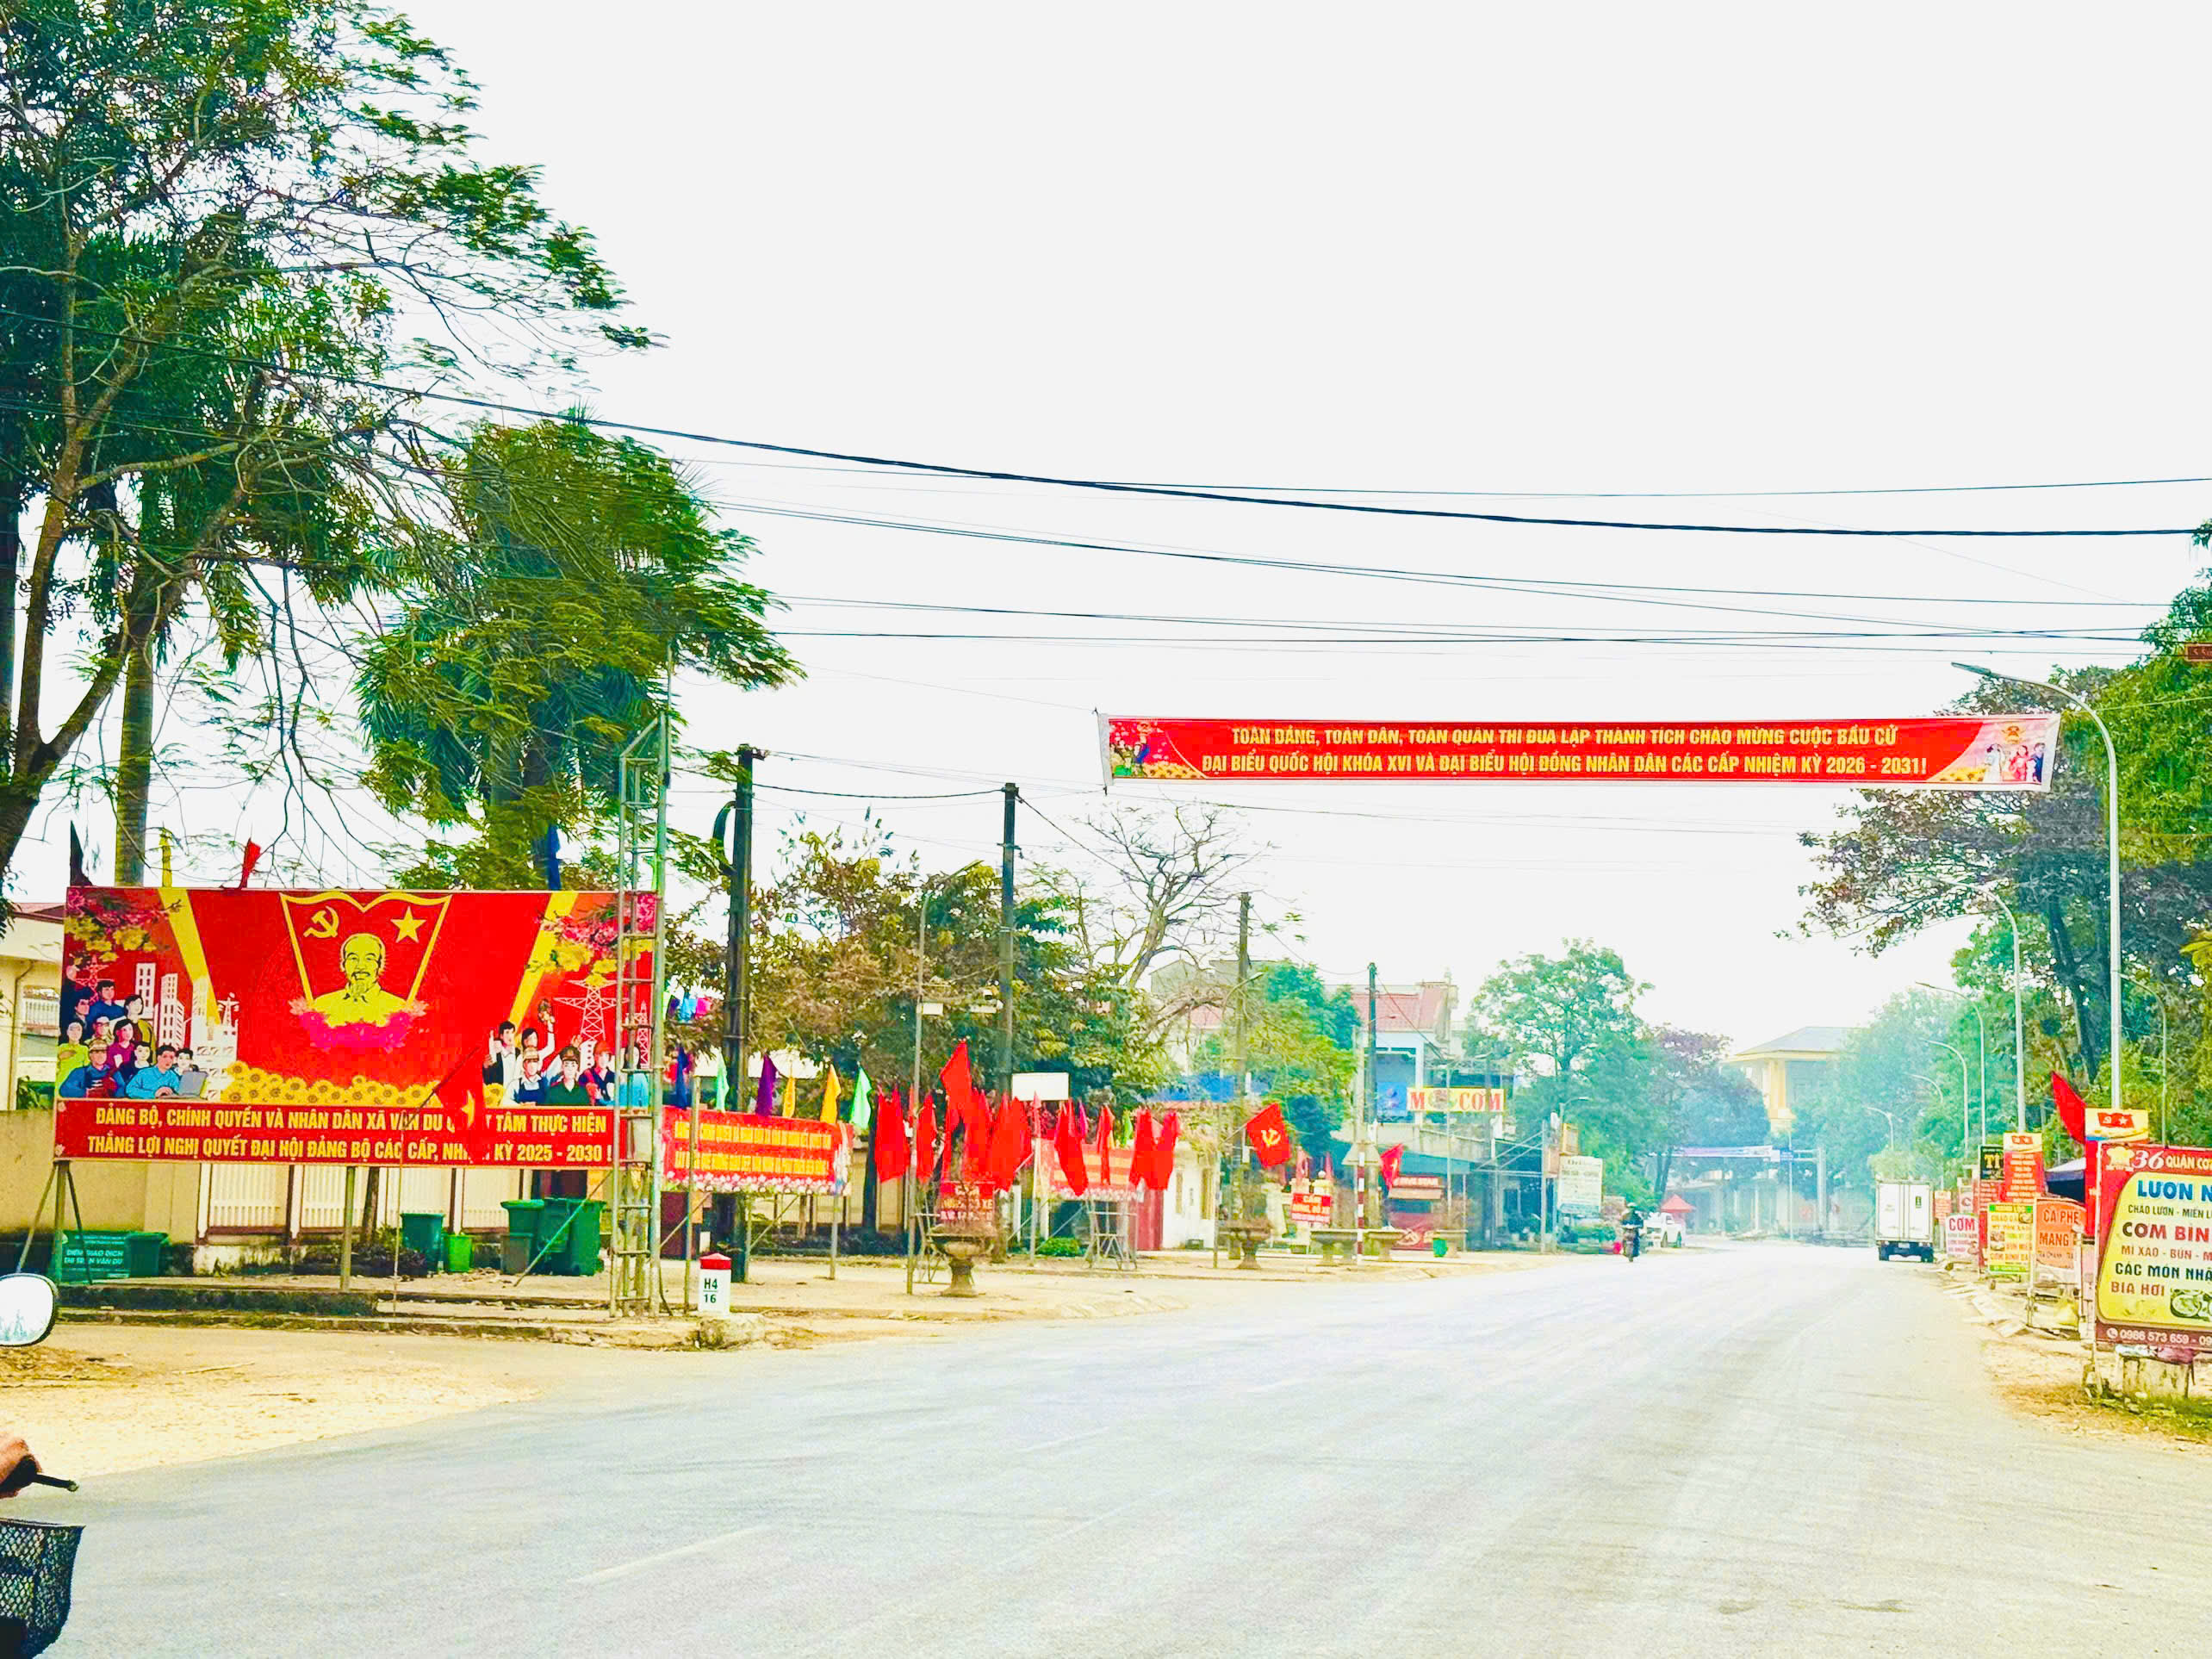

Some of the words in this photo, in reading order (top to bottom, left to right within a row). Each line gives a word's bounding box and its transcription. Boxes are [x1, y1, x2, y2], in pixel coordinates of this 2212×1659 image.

[1275, 724, 1320, 746] ĐẢNG,
[1324, 726, 1364, 744] TOÀN
[1408, 726, 1448, 744] TOÀN
[1452, 726, 1494, 746] QUÂN
[1499, 729, 1522, 744] THI
[1526, 729, 1556, 744] ĐUA
[1561, 727, 1591, 748] LẬP
[1595, 727, 1646, 744] THÀNH
[1650, 726, 1685, 744] TÍCH
[1689, 726, 1732, 744] CHÀO
[1737, 726, 1785, 744] MỪNG
[1789, 726, 1832, 749] CUỘC
[1874, 724, 1898, 745] CỬ
[1202, 755, 1227, 774] ĐẠI
[1269, 750, 1309, 774] QUỐC
[1313, 753, 1339, 774] HỘI
[1342, 752, 1382, 771] KHÓA
[1388, 755, 1412, 771] XVI
[1415, 752, 1435, 771] VÀ
[1439, 755, 1464, 775] ĐẠI
[1469, 749, 1504, 771] BIỂU
[1509, 752, 1535, 775] HỘI
[1586, 752, 1630, 772] NHÂN
[1634, 752, 1667, 772] DÂN
[1671, 752, 1703, 773] CÁC
[1708, 751, 1739, 773] CẤP
[1744, 753, 1797, 777] NHIỆM
[1801, 753, 1822, 774] KỲ
[1826, 756, 1866, 774] 2026
[96, 1103, 135, 1125] ĐẢNG
[139, 1104, 163, 1128] BỘ,
[166, 1106, 211, 1127] CHÍNH
[265, 1108, 284, 1128] VÀ
[288, 1109, 329, 1129] NHÂN
[332, 1109, 363, 1129] DÂN
[366, 1109, 387, 1130] XÃ
[423, 1114, 444, 1131] DU
[495, 1111, 527, 1132] TÂM
[531, 1114, 568, 1136] THỰC
[572, 1112, 606, 1136] HIỆN
[138, 1135, 161, 1158] LỢI
[164, 1137, 199, 1159] NGHỊ
[202, 1134, 248, 1158] QUYẾT
[251, 1140, 276, 1160] ĐẠI
[279, 1137, 303, 1161] HỘI
[308, 1134, 347, 1159] ĐẢNG
[351, 1138, 370, 1162] BỘ
[374, 1138, 402, 1159] CÁC
[407, 1137, 438, 1162] CẤP,
[494, 1140, 513, 1161] KỲ
[517, 1144, 553, 1161] 2025
[566, 1145, 602, 1162] 2030
[606, 1145, 612, 1162] !
[2131, 1150, 2165, 1170] 36
[704, 1278, 718, 1289] H4
[2111, 1281, 2134, 1294] BIA
[704, 1294, 717, 1303] 16
